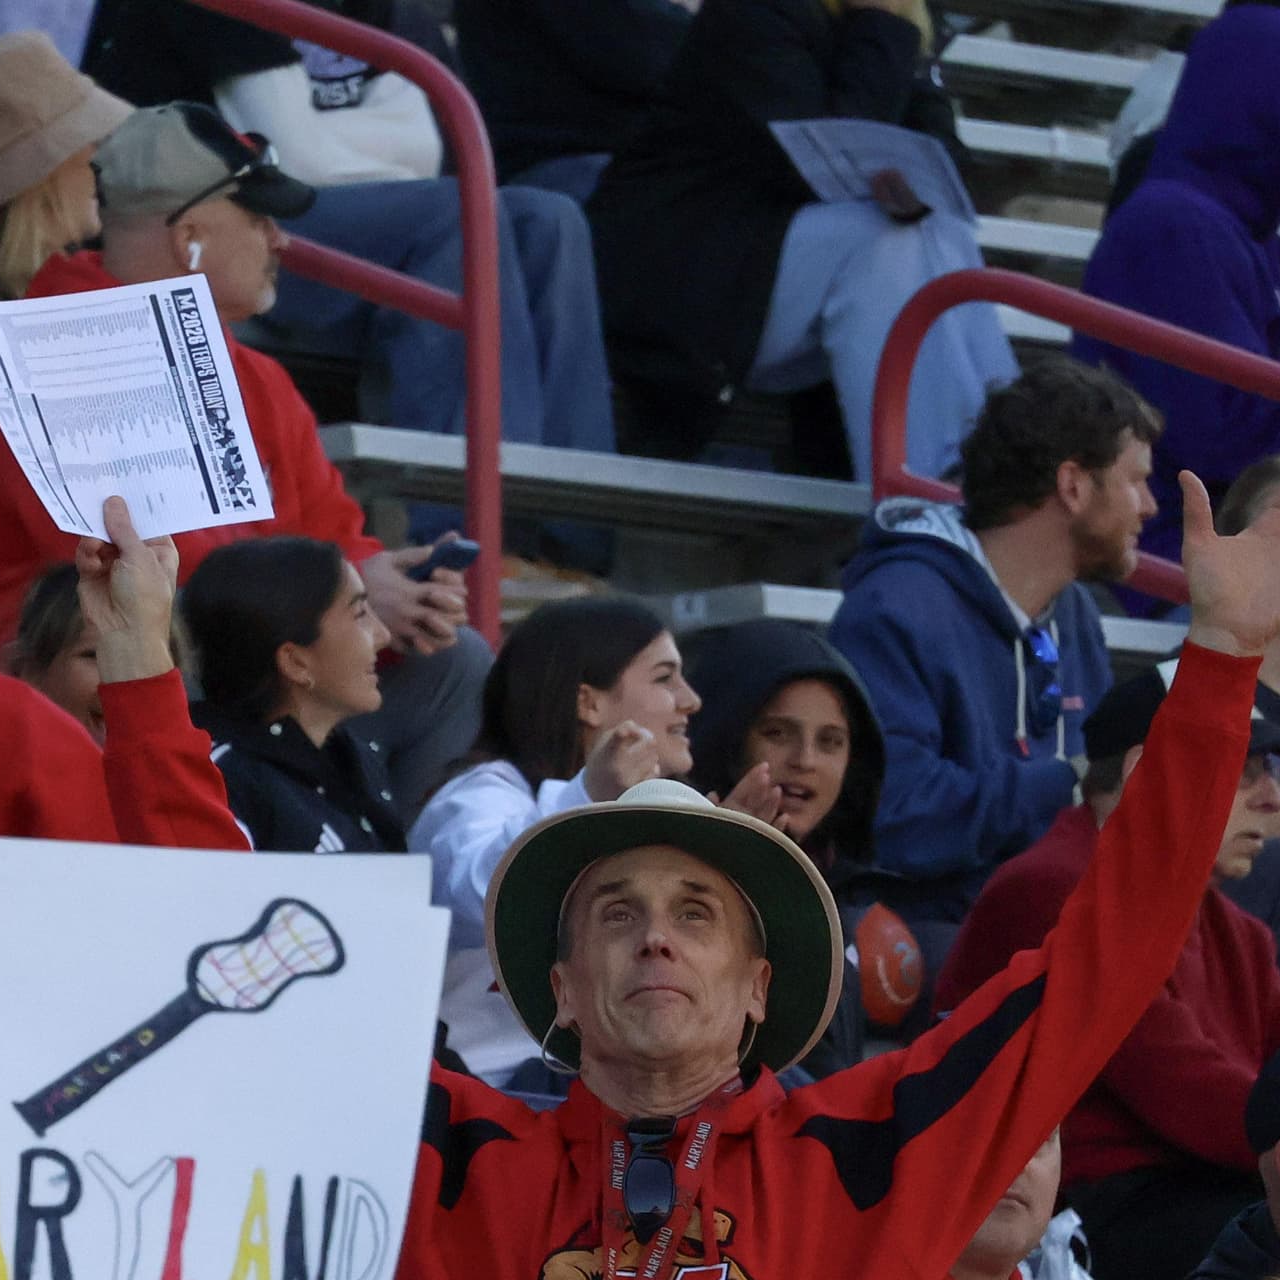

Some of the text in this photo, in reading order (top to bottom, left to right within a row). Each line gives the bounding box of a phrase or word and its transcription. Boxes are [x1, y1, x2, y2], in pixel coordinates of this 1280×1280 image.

[179, 311, 205, 346] 2026
[190, 344, 218, 378] TERPS
[201, 375, 226, 410] TODAY
[611, 1139, 625, 1190] MARYLAND
[684, 1120, 712, 1170] MARYLAND
[642, 1226, 674, 1280] MARYLAND
